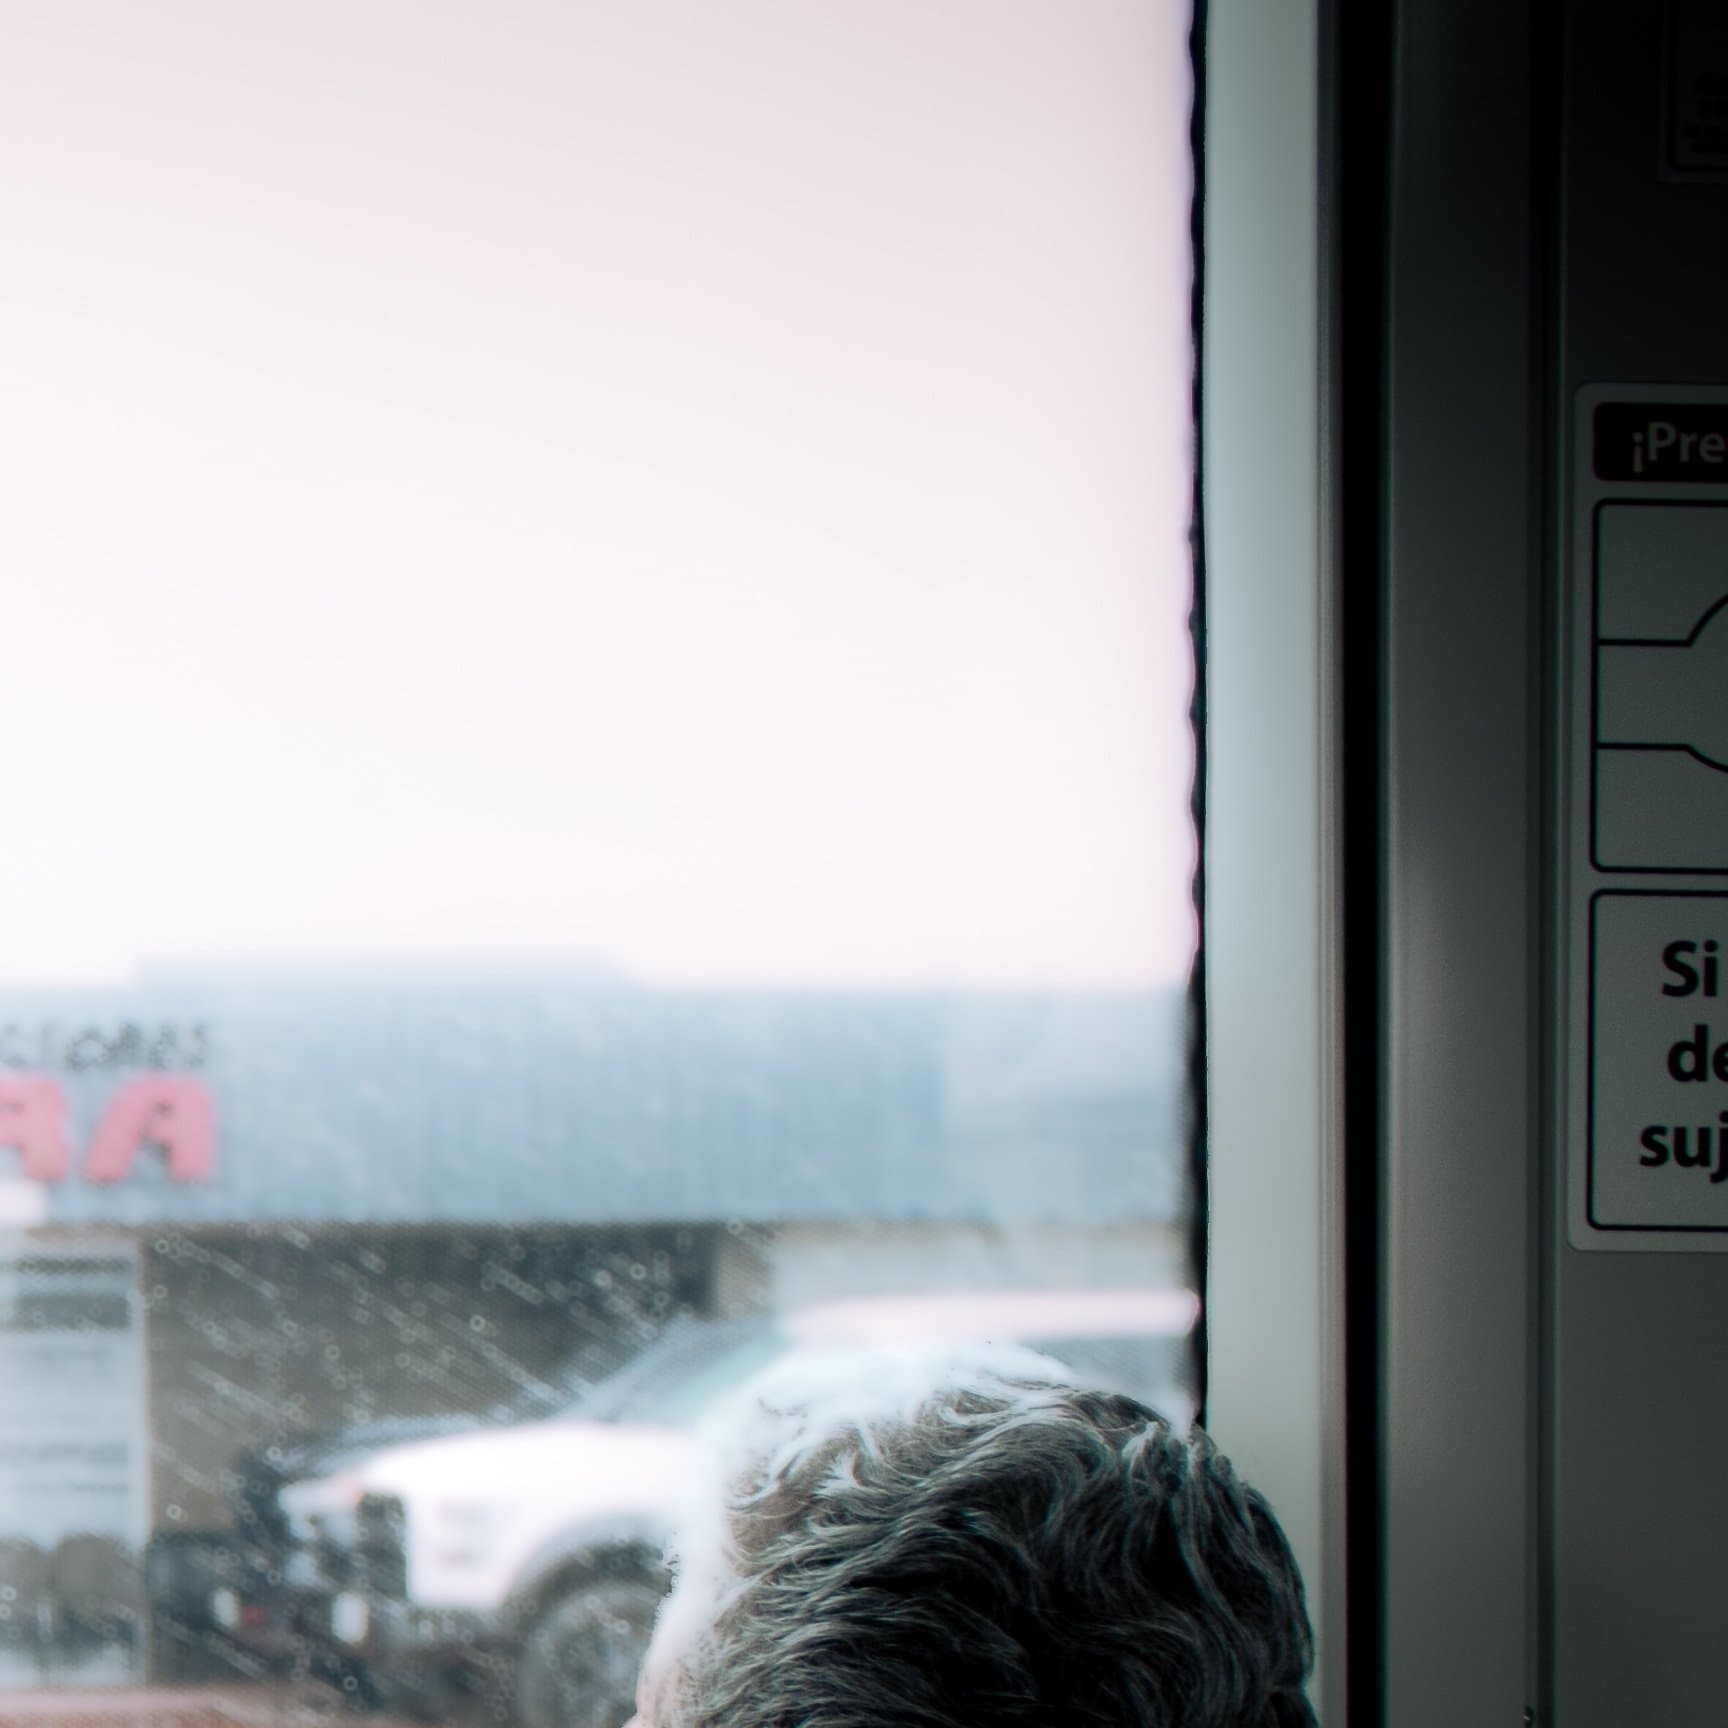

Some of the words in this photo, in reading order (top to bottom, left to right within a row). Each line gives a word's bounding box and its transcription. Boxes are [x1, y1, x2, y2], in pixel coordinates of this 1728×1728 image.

[1632, 419, 1727, 474] ¡Pre
[1661, 939, 1719, 997] Si
[1639, 1110, 1727, 1184] suj
